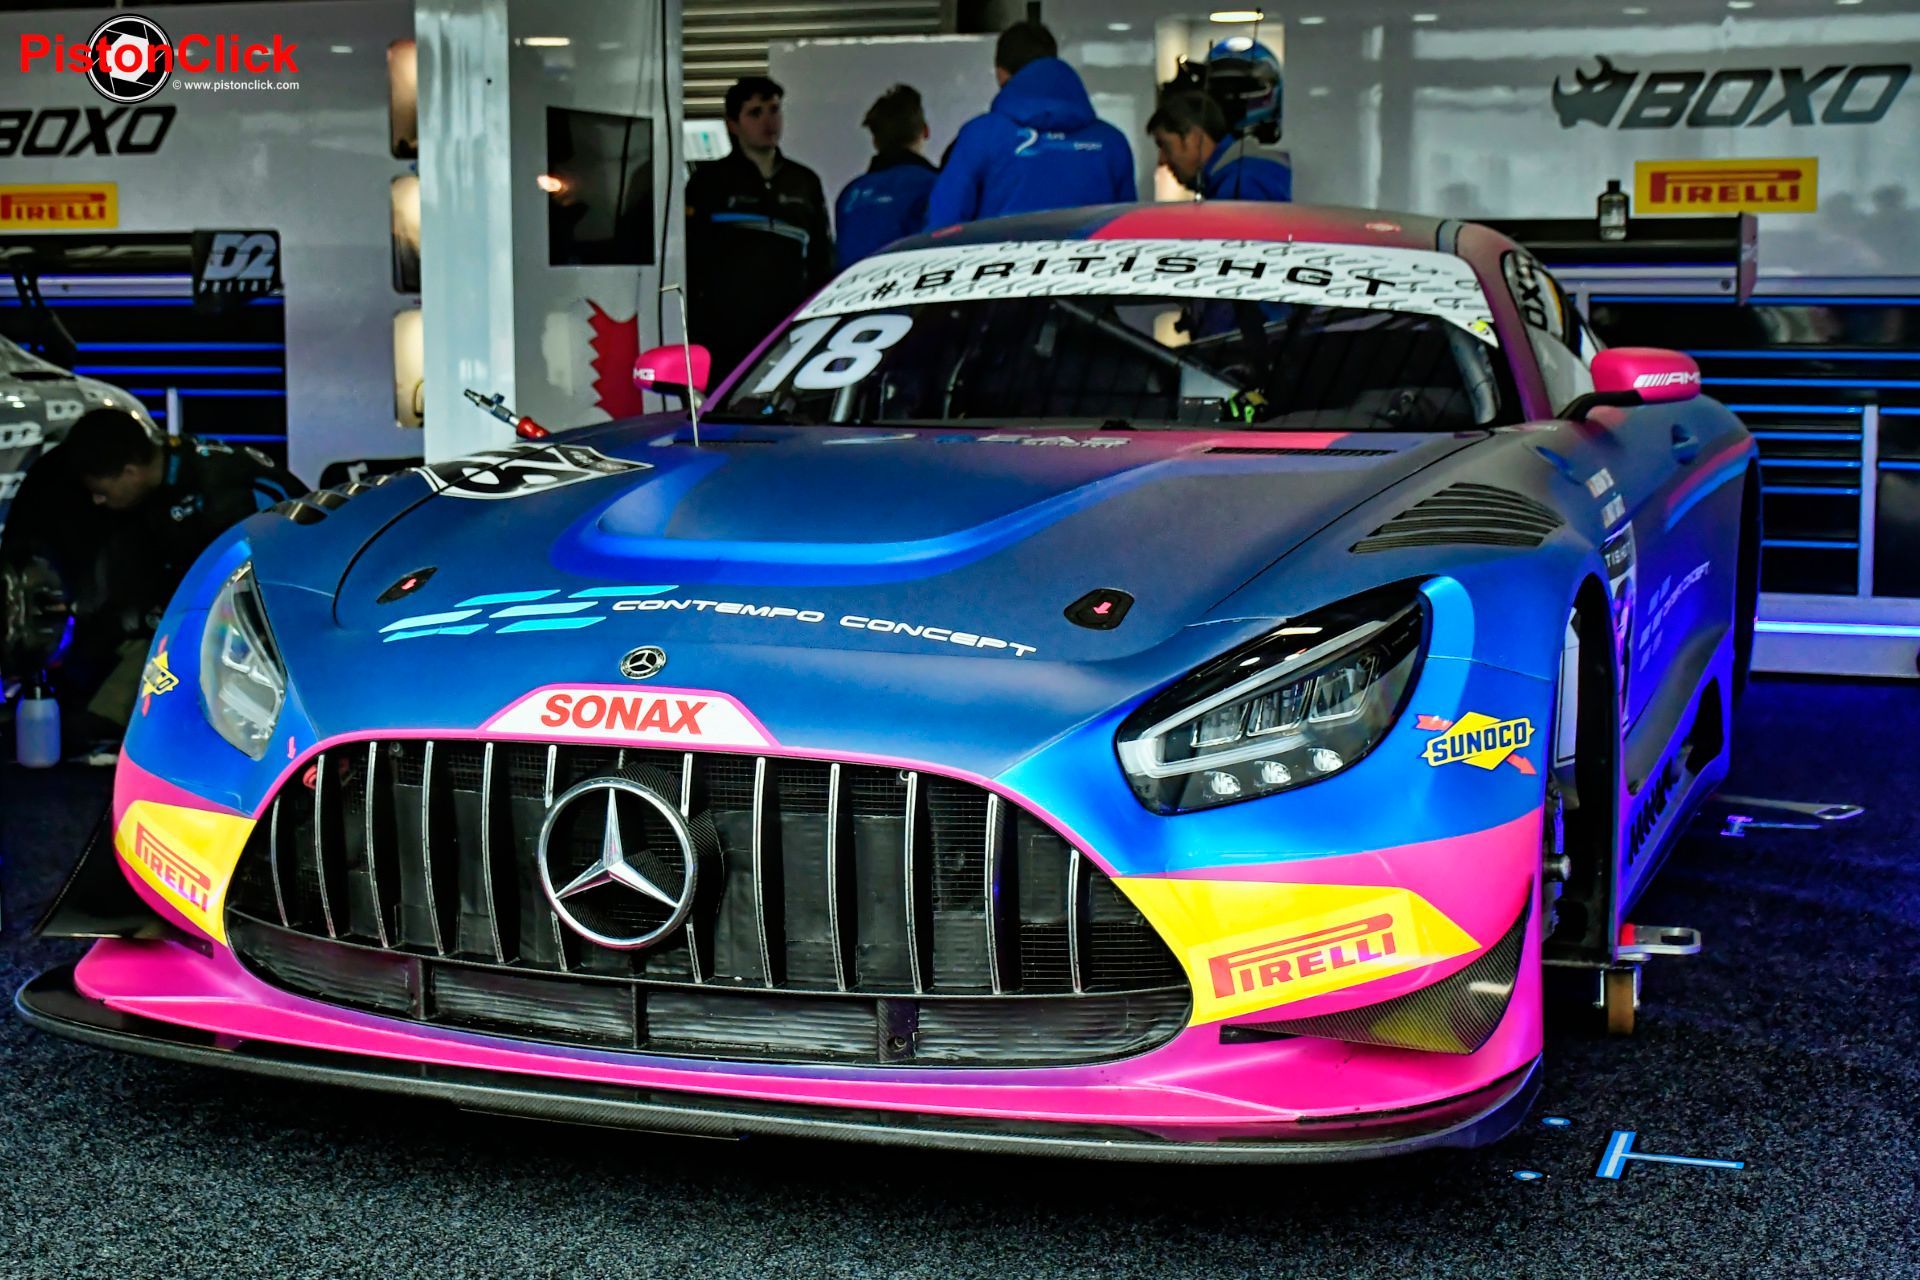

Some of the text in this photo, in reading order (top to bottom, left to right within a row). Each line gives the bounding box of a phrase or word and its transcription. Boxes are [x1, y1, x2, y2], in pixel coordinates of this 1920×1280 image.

[1618, 64, 1912, 129] BOXO
[0, 193, 107, 221] PIRELLI
[1649, 169, 1802, 203] PIRELLI
[203, 233, 276, 280] D2
[752, 314, 913, 393] 18
[611, 599, 1037, 658] CONTEMPO CONCEPT
[540, 694, 708, 736] SONAX
[1431, 721, 1530, 763] SUNOCO
[135, 821, 211, 912] PIRELLI
[1208, 913, 1397, 999] PIRELLI
